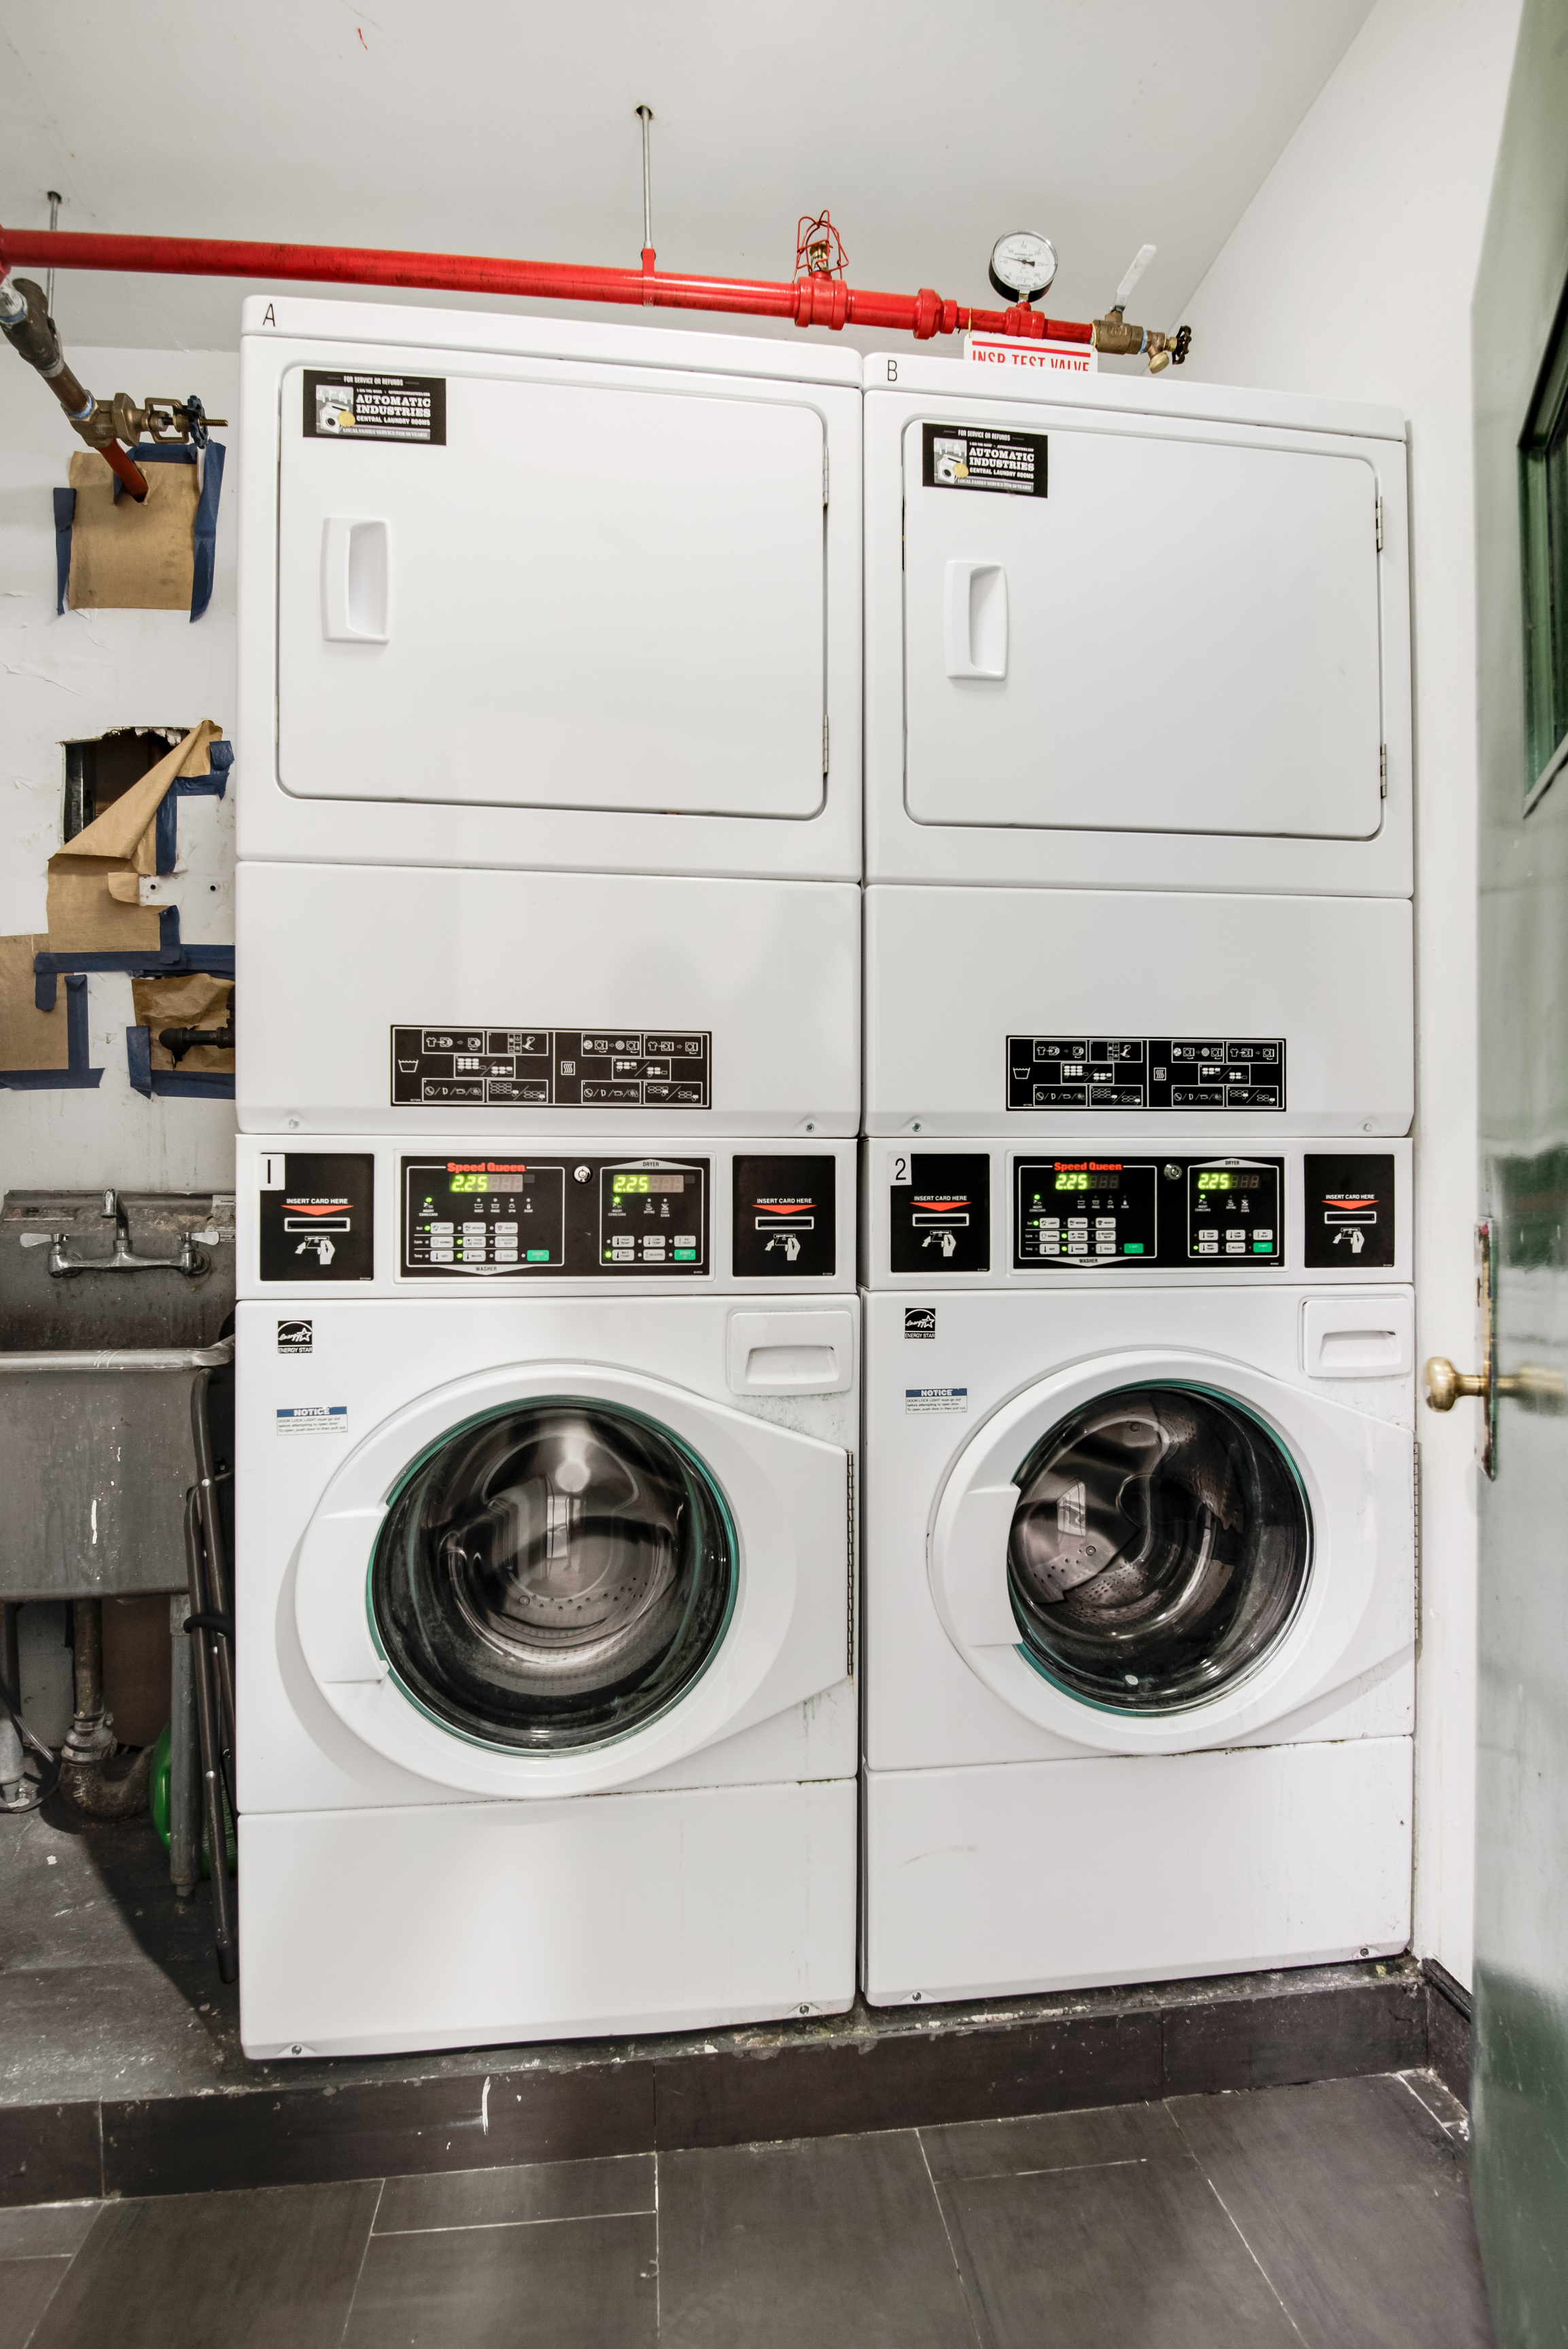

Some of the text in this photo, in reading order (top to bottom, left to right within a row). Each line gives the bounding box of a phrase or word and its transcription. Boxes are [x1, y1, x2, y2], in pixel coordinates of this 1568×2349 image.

[262, 303, 275, 327] A
[1012, 354, 1045, 367] TEST
[888, 360, 898, 381] B
[354, 376, 373, 384] SERVICE
[382, 378, 404, 386] REFUNDS
[356, 394, 431, 408] AUTOMATIC
[356, 404, 431, 417] INDUSTRIES
[383, 417, 410, 425] LAUNDRY
[967, 430, 984, 438] SERVICE
[992, 432, 1011, 441] REFUNDS
[969, 447, 1034, 462] AUTOMATIC
[969, 457, 1034, 472] INDUSTRIES
[993, 469, 1016, 477] LAUNDRY
[447, 1162, 525, 1174] Speed Queen
[894, 1158, 907, 1180] 2
[1054, 1162, 1122, 1172] Speed Queen
[451, 1175, 487, 1191] 2.25
[614, 1177, 648, 1192] 2.25
[1056, 1174, 1087, 1189] 2.25
[1198, 1174, 1228, 1189] 2.25
[294, 1408, 330, 1416] NOTICE
